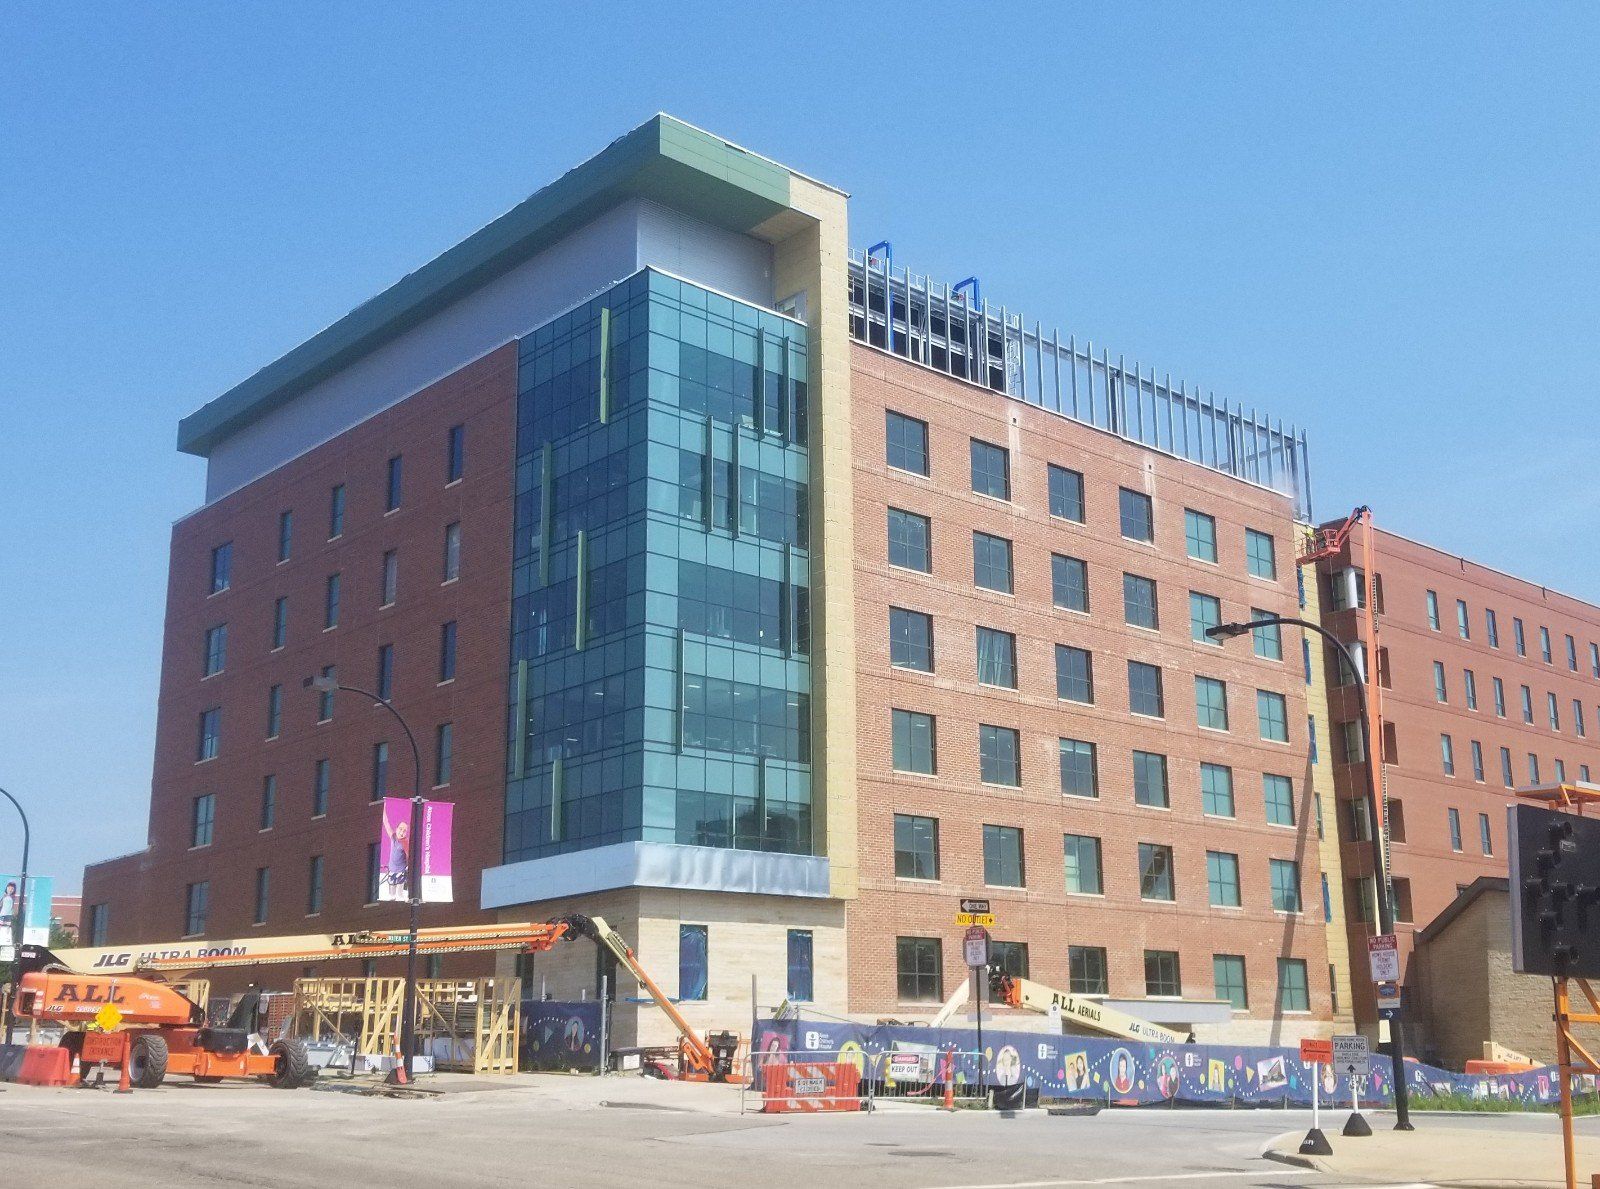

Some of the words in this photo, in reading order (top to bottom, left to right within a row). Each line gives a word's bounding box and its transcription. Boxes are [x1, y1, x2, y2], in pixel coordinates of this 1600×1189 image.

[957, 914, 966, 923] NO
[93, 953, 132, 968] JLG
[54, 983, 124, 1003] ALL
[1051, 993, 1076, 1013] ALL
[1077, 1005, 1101, 1022] AERIALS
[1129, 1022, 1140, 1033] JLG
[1142, 1028, 1159, 1039] ULTRA
[1334, 1042, 1366, 1050] PARKING
[891, 1065, 905, 1073] KEEP
[906, 1065, 918, 1073] OUT
